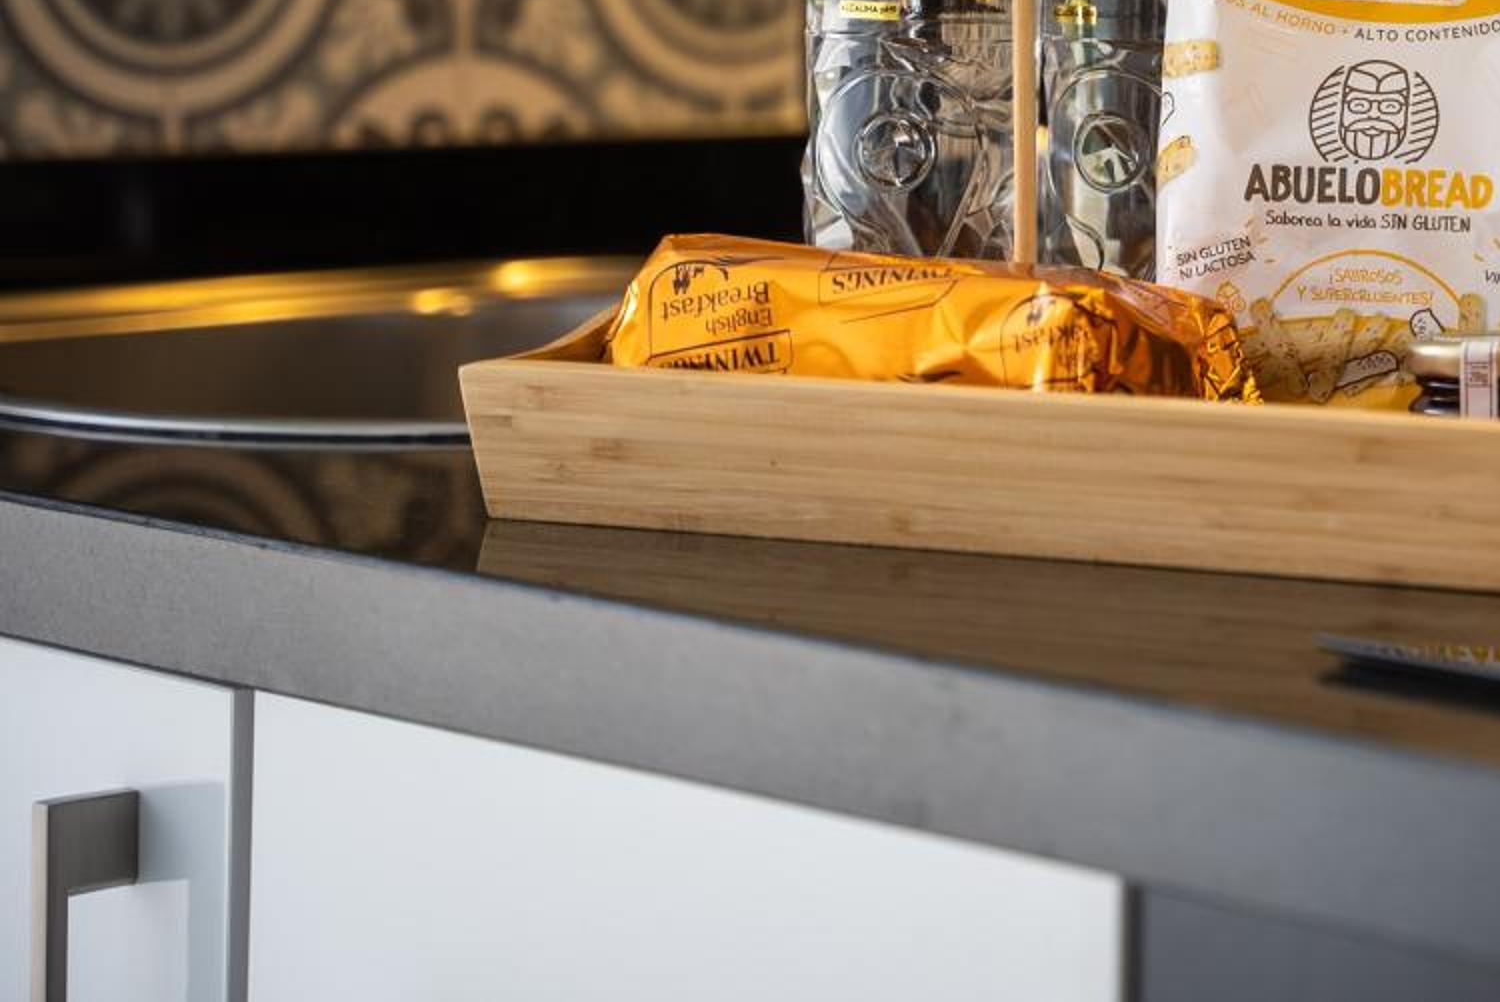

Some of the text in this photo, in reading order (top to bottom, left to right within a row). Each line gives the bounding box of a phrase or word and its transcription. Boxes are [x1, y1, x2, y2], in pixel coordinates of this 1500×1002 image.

[1252, 3, 1269, 18] AL
[1276, 10, 1337, 35] HORNO
[1354, 27, 1399, 43] ALTO
[1244, 164, 1494, 210] ABUELOBREAD
[1265, 210, 1472, 233] Saborea la vida SIN GLUTEN
[1176, 235, 1252, 266] SIN GLUTEN
[1179, 251, 1256, 281] NI LACTOSA
[661, 281, 770, 323] Breakfast
[1296, 285, 1307, 302] Y
[704, 308, 773, 337] English
